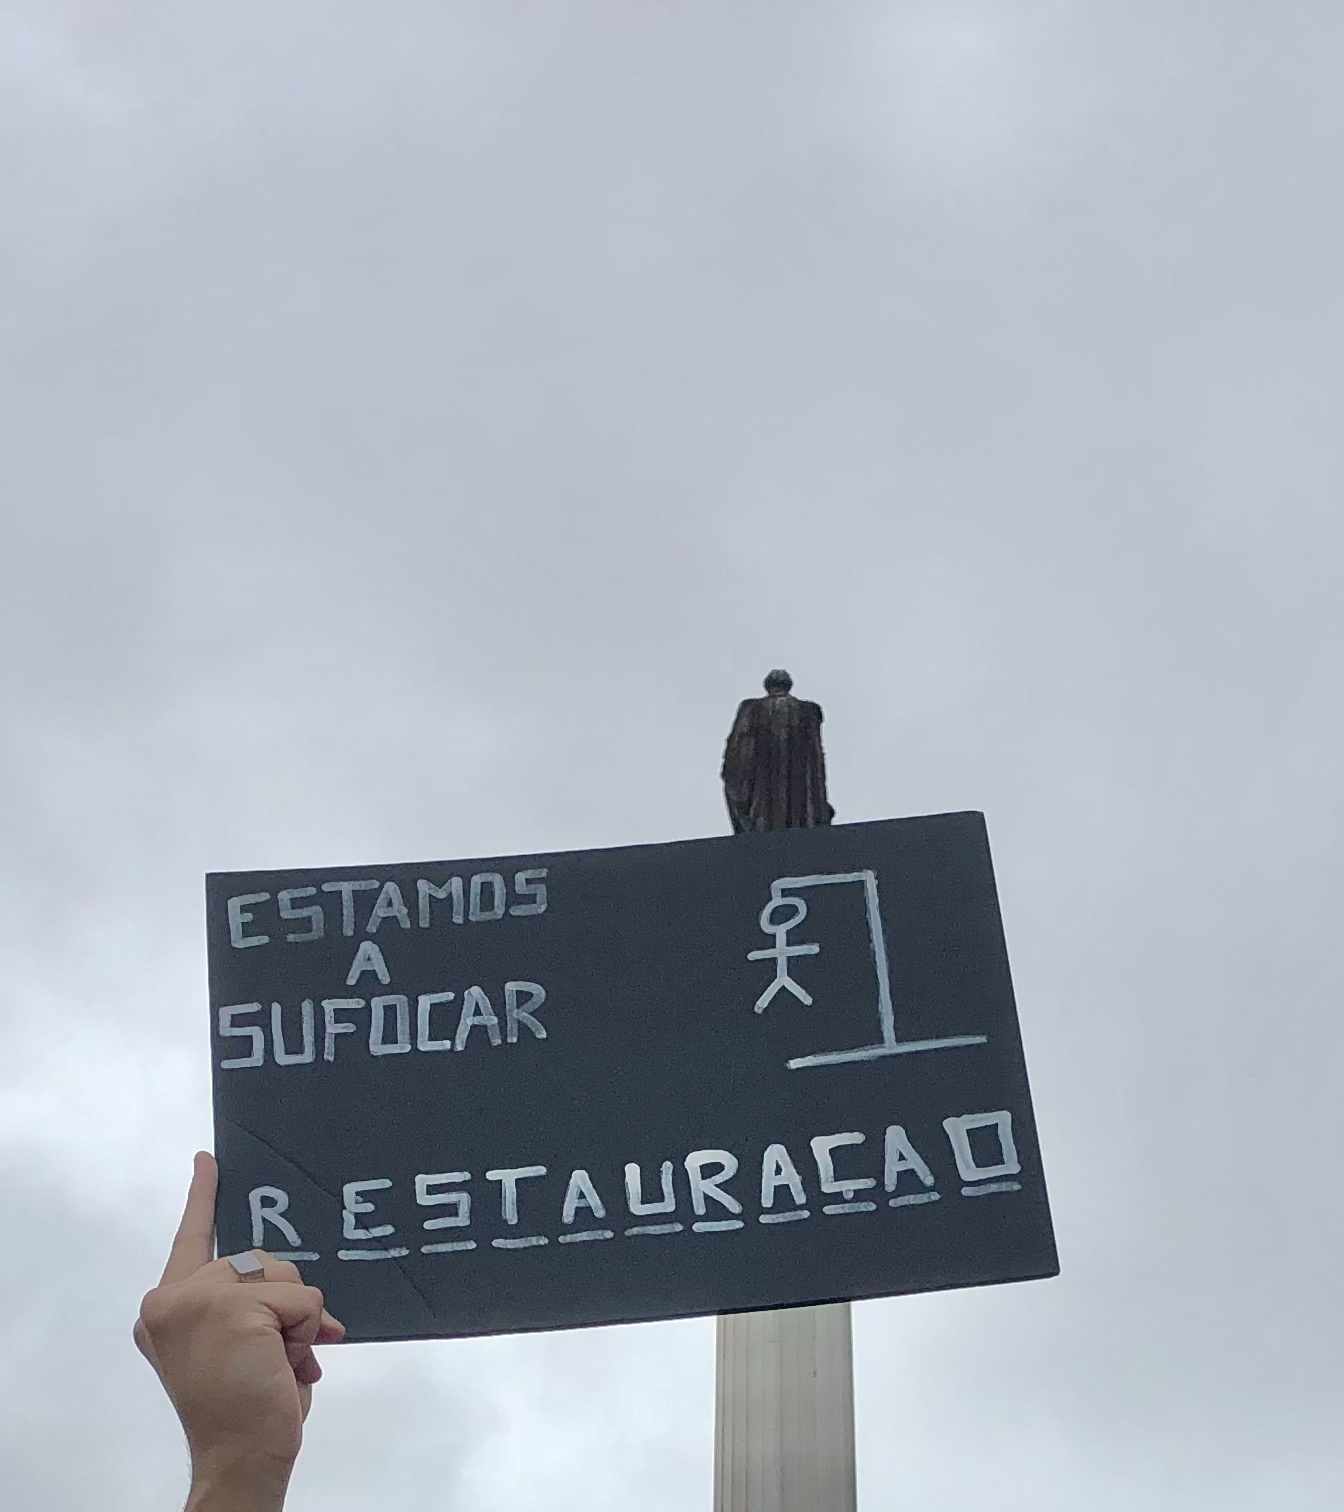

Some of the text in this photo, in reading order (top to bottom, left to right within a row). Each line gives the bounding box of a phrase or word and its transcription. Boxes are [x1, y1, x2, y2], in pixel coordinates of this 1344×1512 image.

[227, 868, 549, 948] ESTAMOS
[346, 941, 390, 985] A
[218, 981, 547, 1068] SUFOCAR
